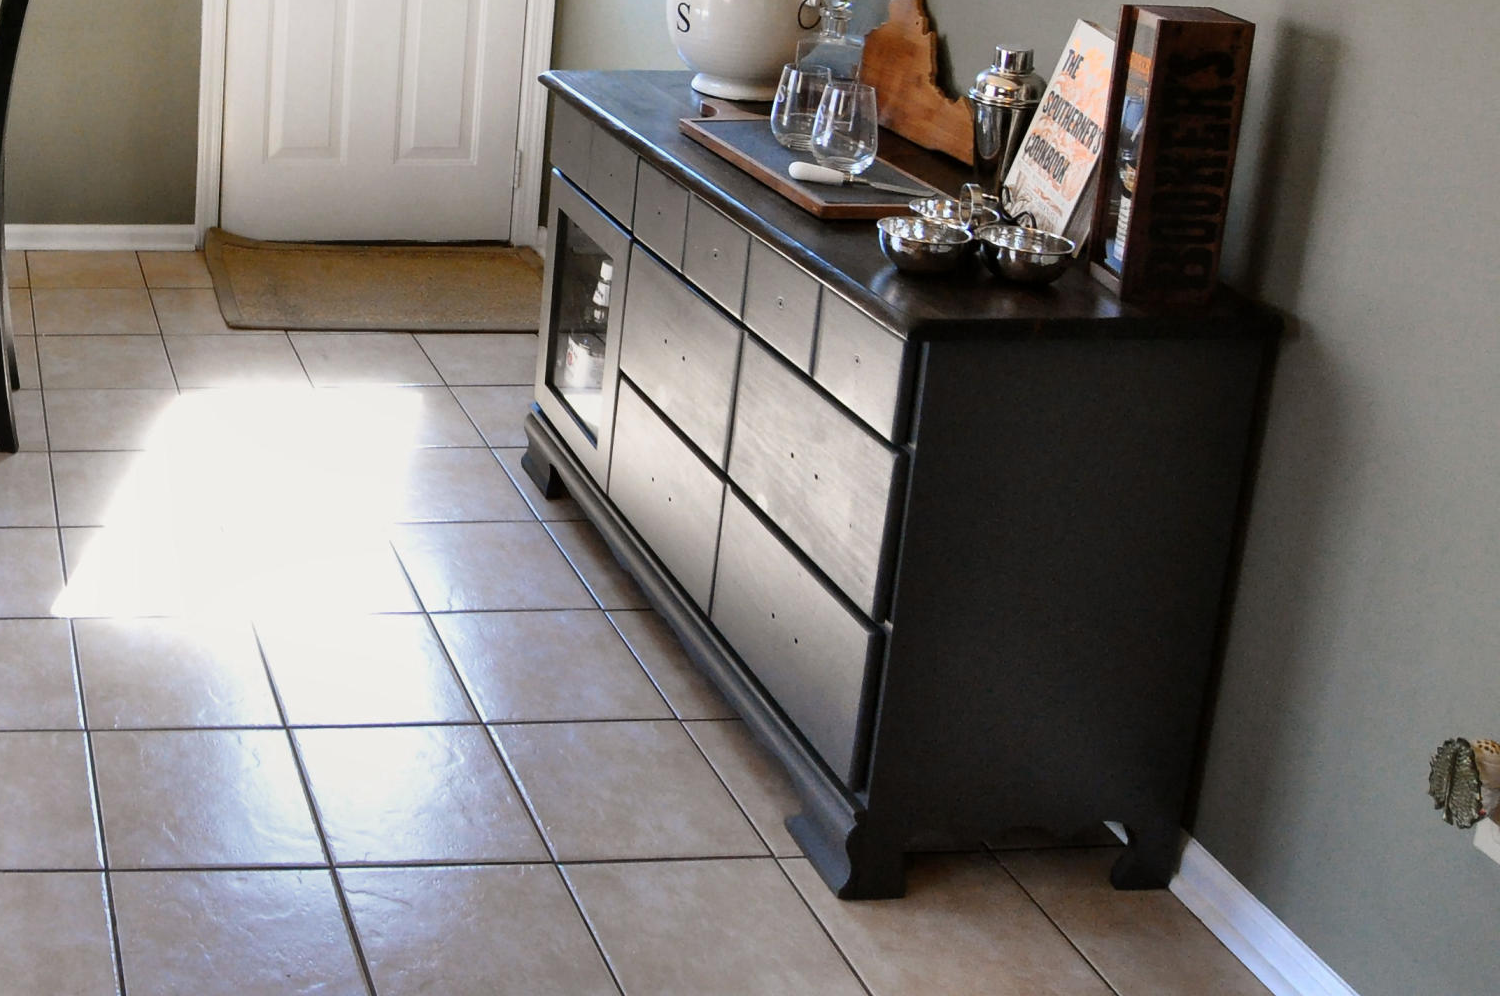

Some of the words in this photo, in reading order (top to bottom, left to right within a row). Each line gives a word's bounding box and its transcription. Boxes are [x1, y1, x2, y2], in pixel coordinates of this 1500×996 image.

[676, 2, 690, 32] S
[1062, 49, 1084, 80] THE
[1042, 91, 1104, 155] SOUTHERNER'S
[1024, 133, 1070, 184] COOKBOOK
